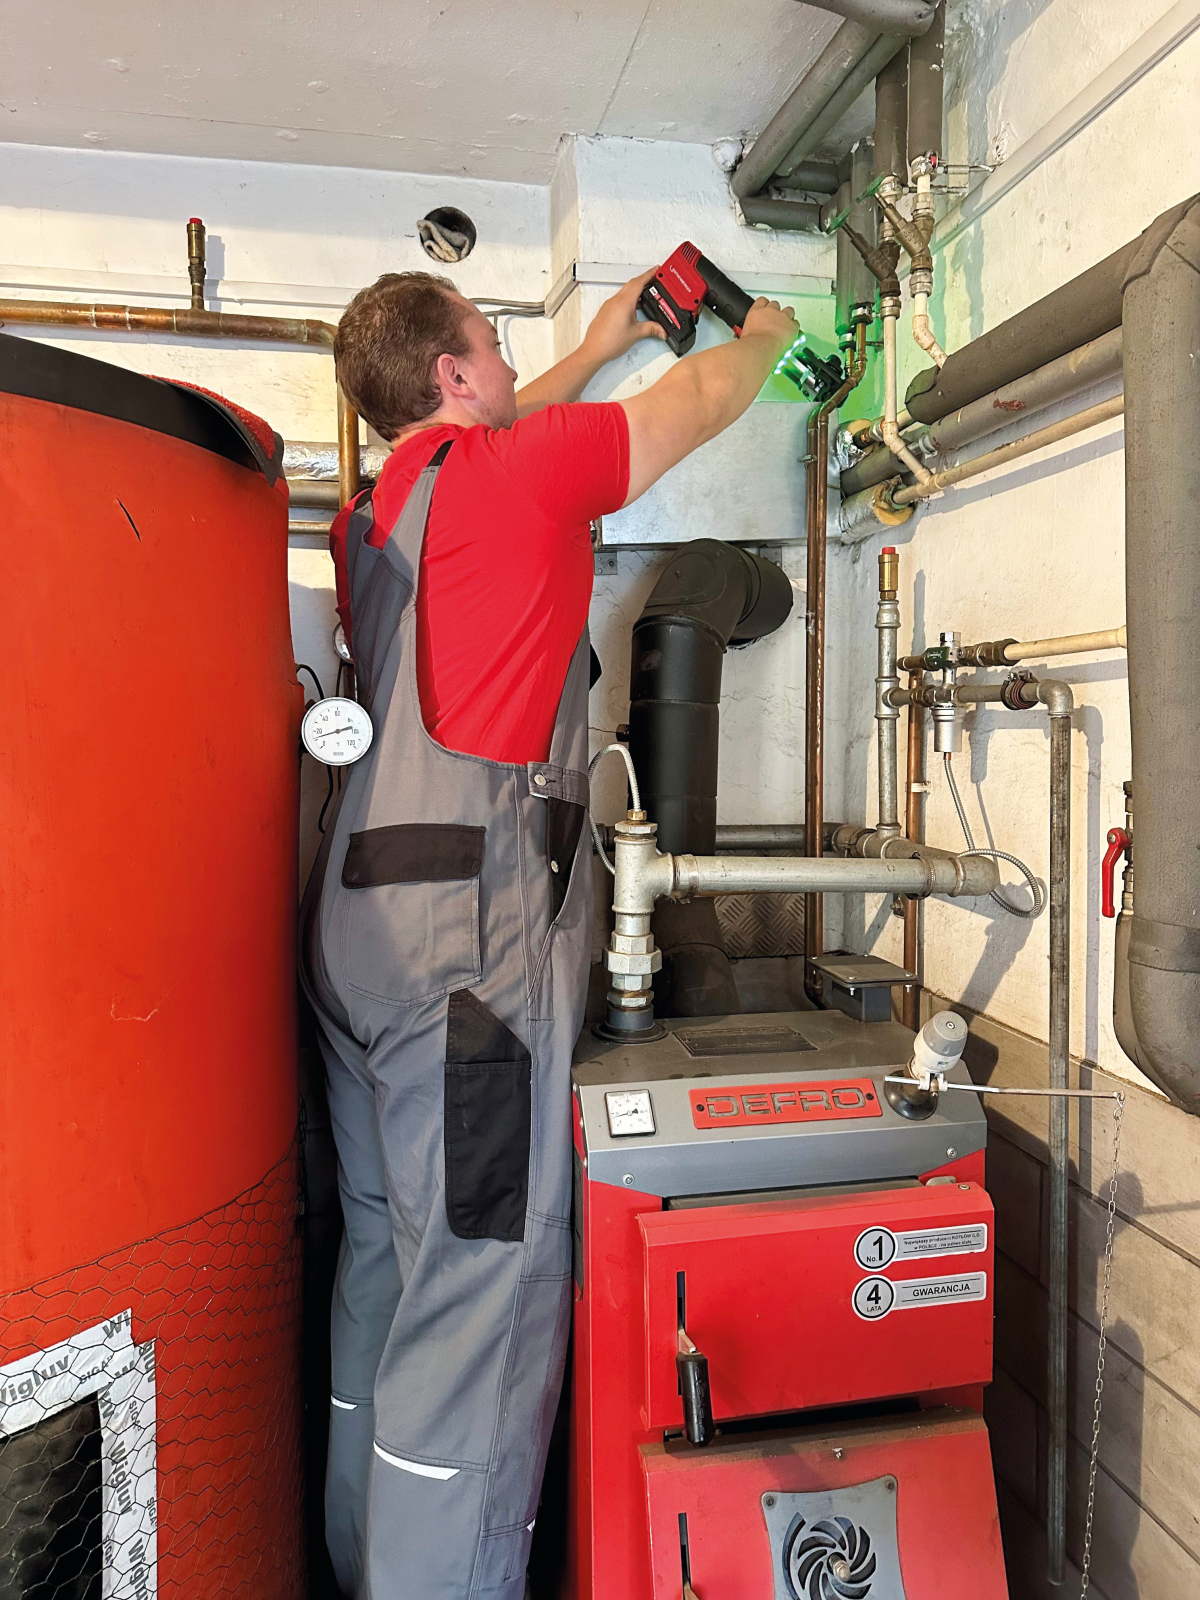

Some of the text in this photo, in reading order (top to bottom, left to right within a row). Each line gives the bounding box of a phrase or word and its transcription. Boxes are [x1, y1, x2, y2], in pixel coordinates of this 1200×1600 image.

[706, 1087, 866, 1119] DEFRO
[872, 1235, 884, 1261] 1
[866, 1283, 882, 1305] 4
[912, 1284, 970, 1297] GWARANCJA
[866, 1305, 882, 1313] LATA
